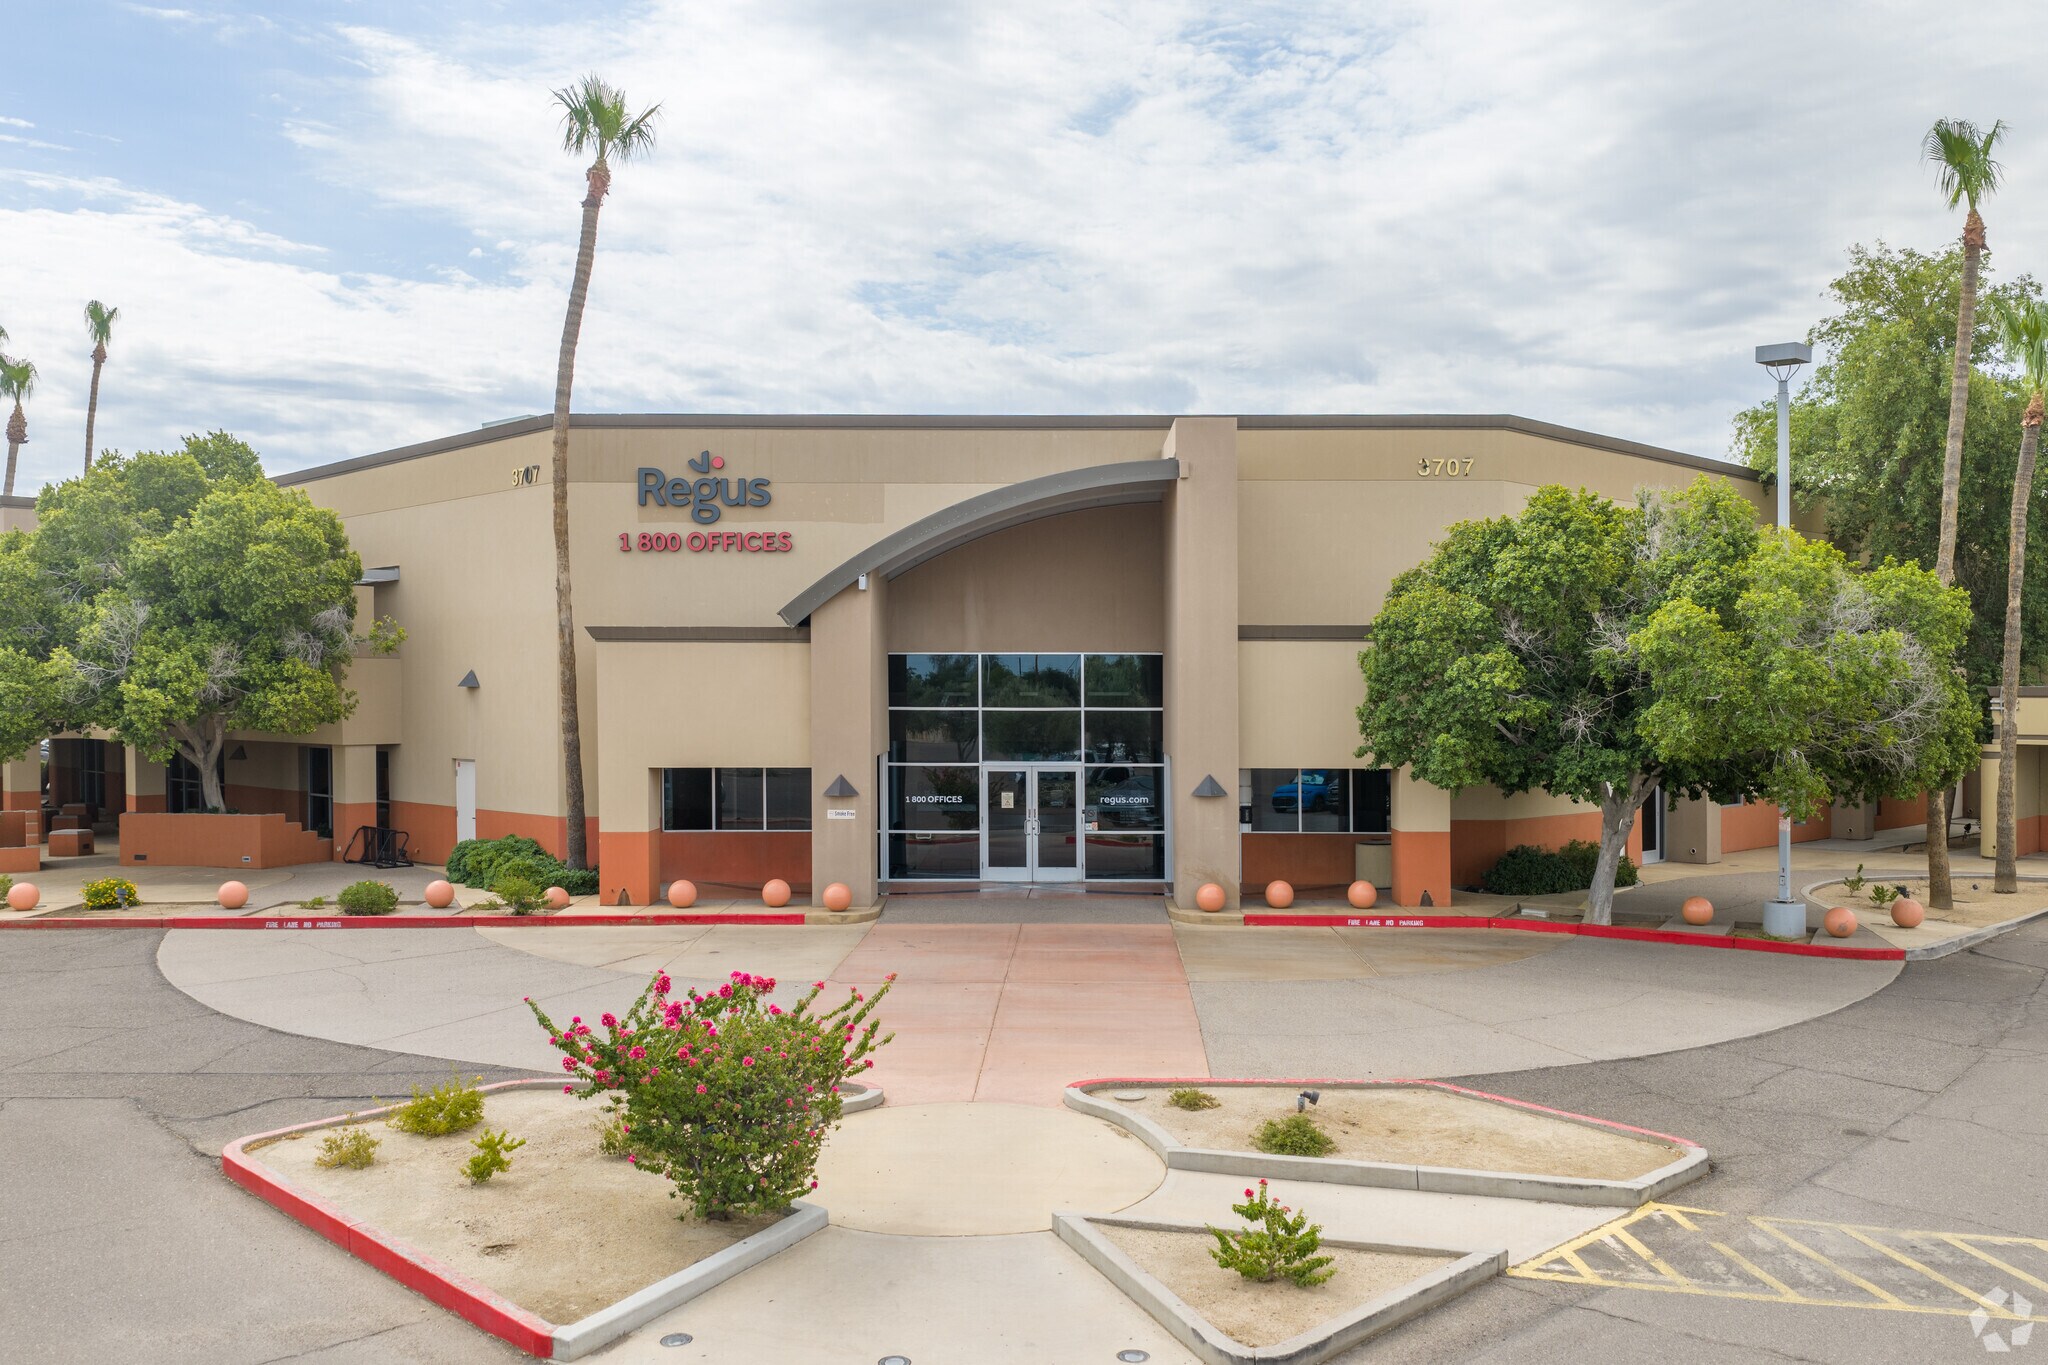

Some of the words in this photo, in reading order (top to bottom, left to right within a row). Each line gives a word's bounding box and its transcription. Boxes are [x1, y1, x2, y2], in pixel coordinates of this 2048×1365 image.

[512, 465, 540, 486] 3707
[1418, 458, 1474, 476] 3707
[638, 467, 772, 524] Regus
[618, 532, 632, 552] 1
[637, 532, 682, 552] 800
[686, 531, 793, 552] OFFICES
[927, 795, 963, 803] OFFICES
[1100, 796, 1149, 805] regus.com
